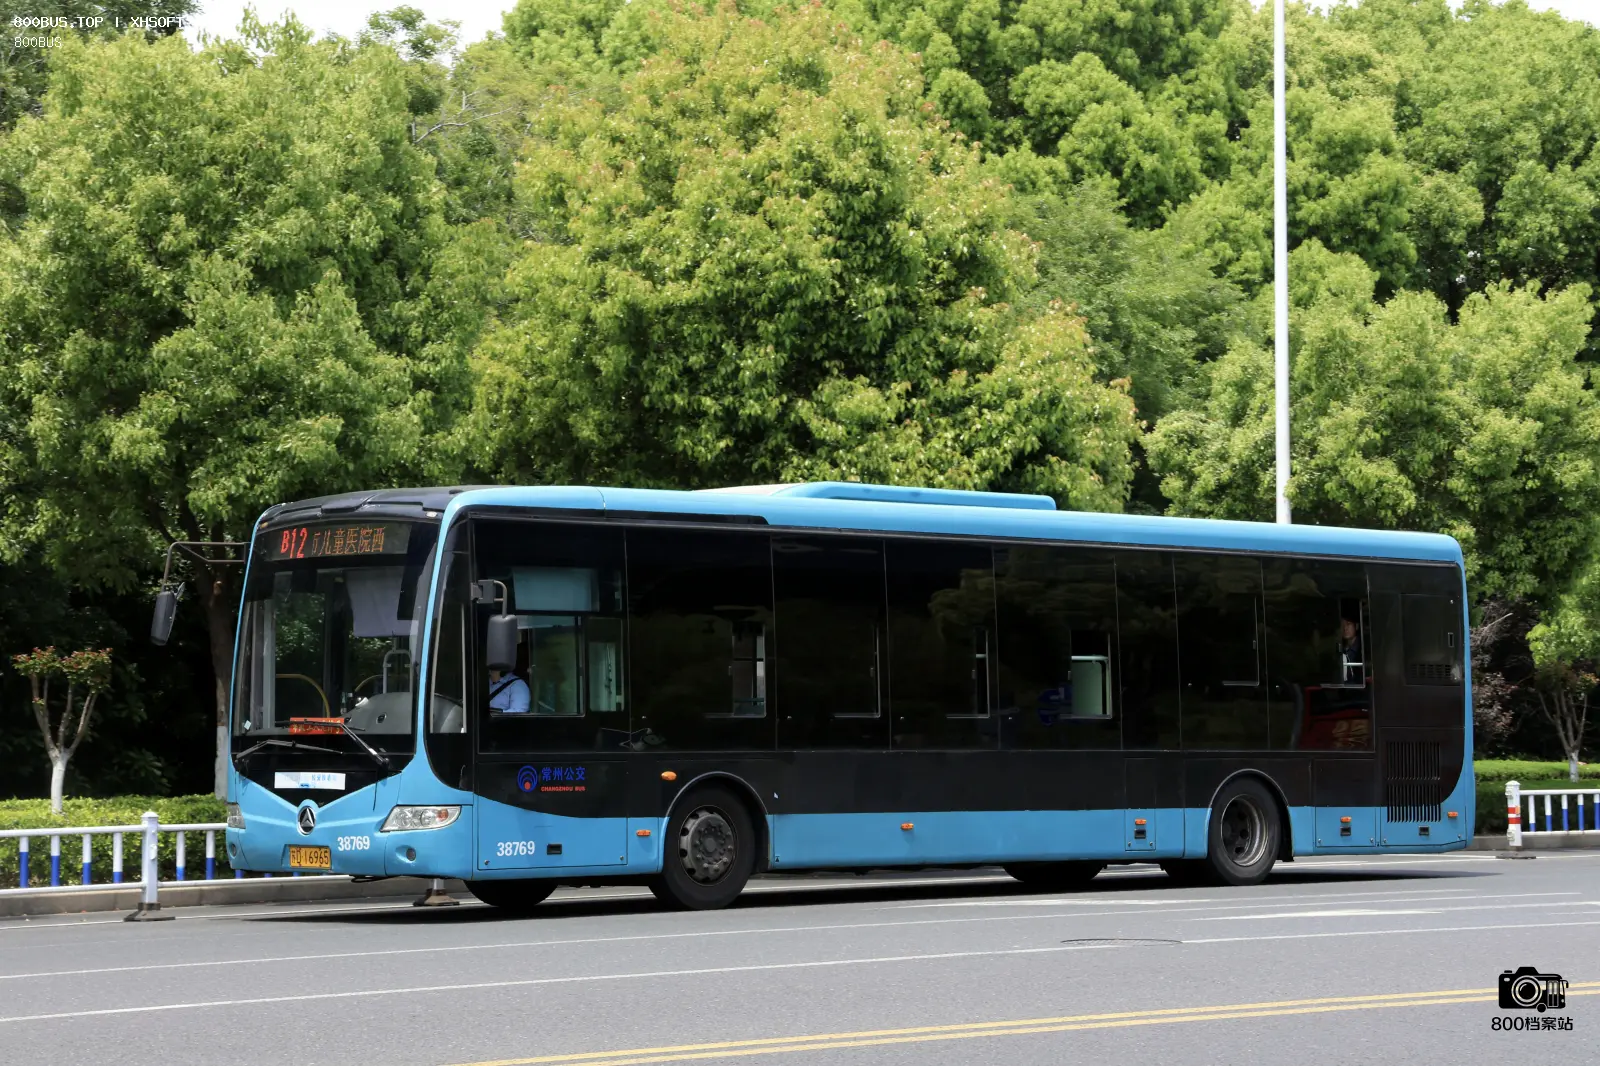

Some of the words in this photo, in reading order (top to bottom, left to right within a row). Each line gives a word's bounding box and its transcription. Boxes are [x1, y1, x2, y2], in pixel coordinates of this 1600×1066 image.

[280, 527, 308, 558] B12
[541, 766, 586, 781] 常州公交
[337, 835, 370, 851] 38769
[496, 840, 536, 857] 38769
